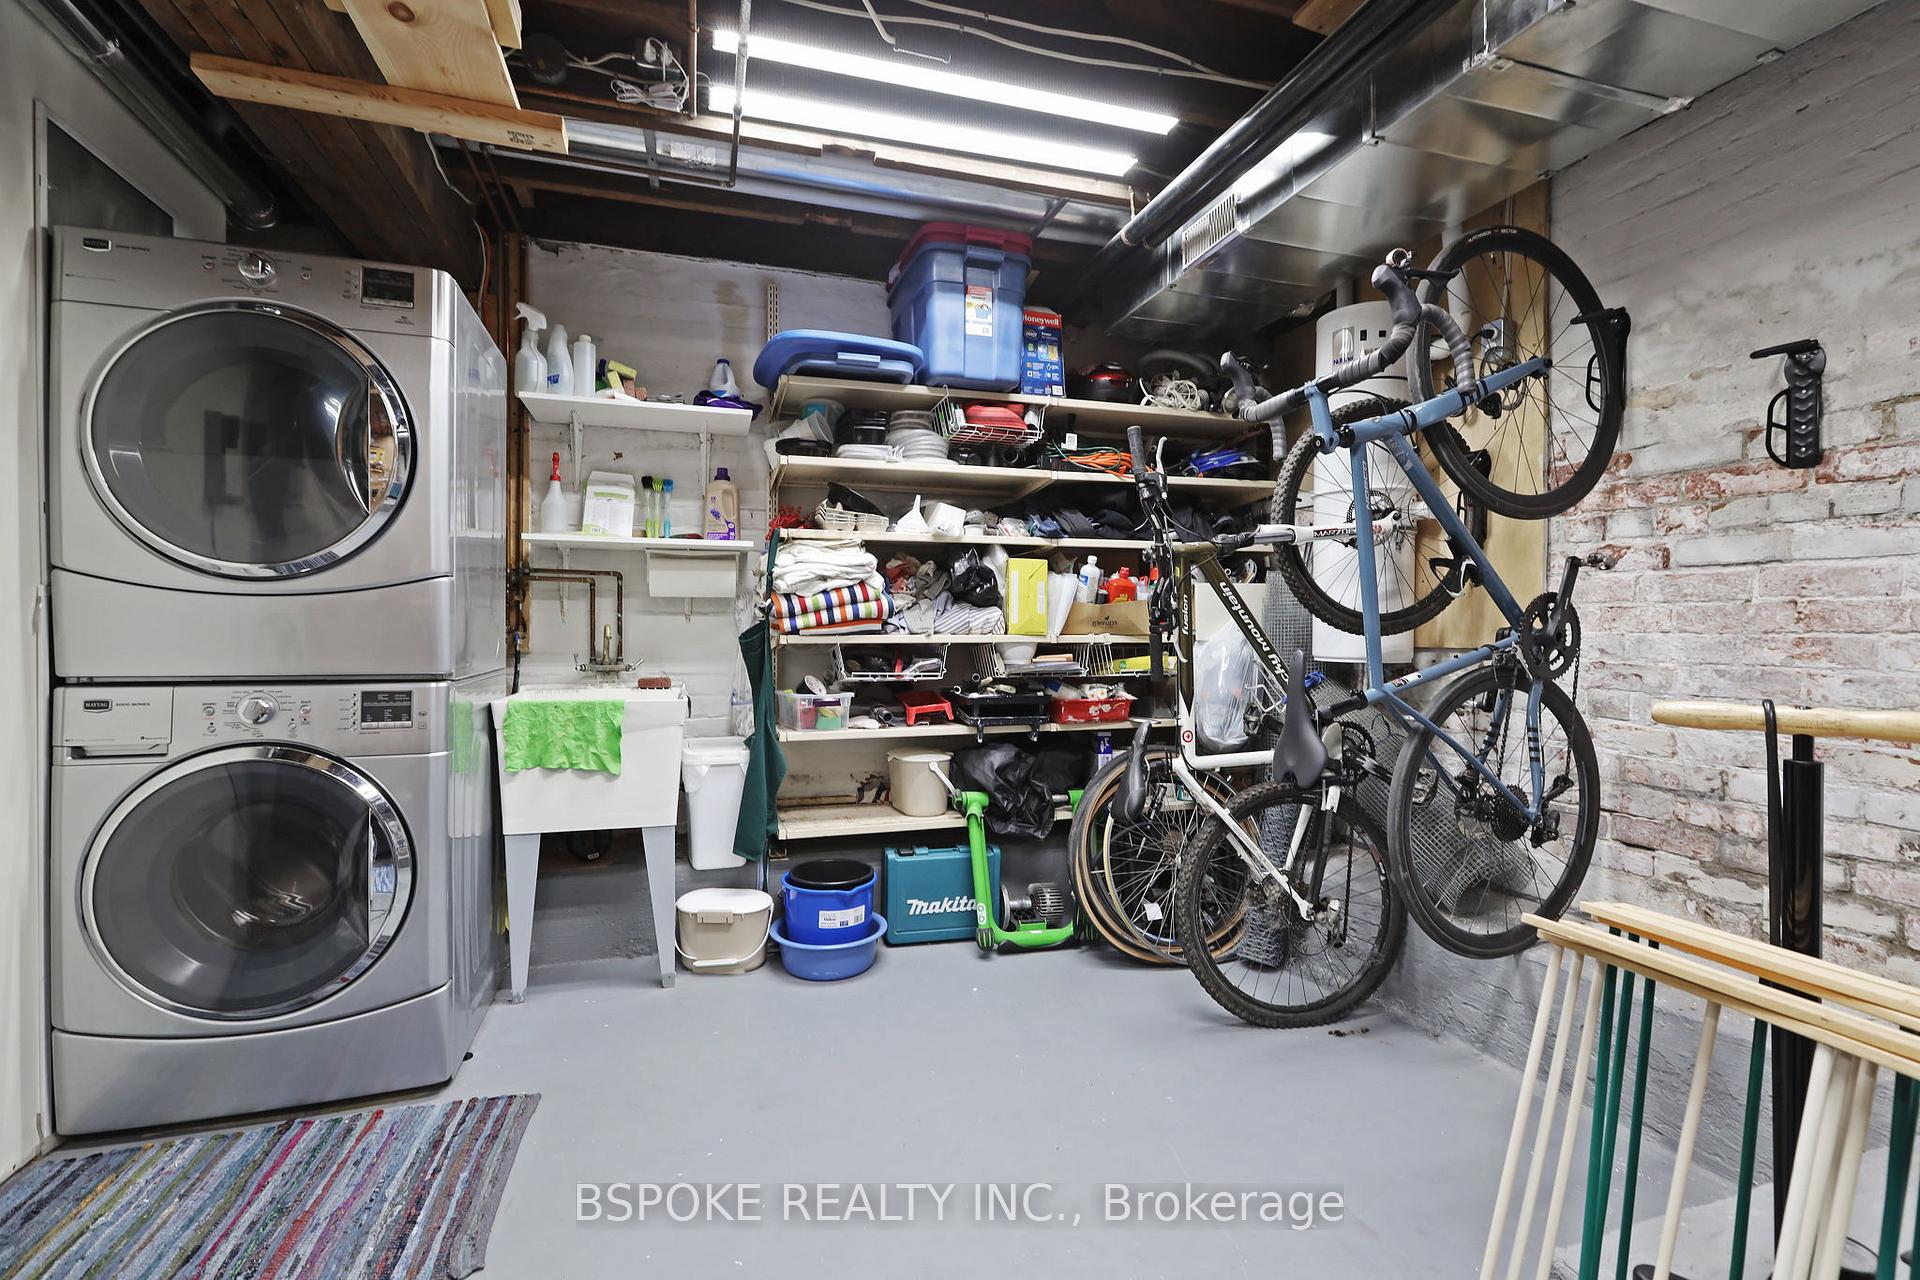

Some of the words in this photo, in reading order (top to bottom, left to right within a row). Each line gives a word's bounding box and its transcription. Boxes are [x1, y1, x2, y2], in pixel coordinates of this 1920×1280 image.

[1023, 313, 1060, 327] Honeywell
[1181, 594, 1189, 636] fusion
[1091, 619, 1118, 627] glerups
[85, 701, 109, 709] MAYTAG
